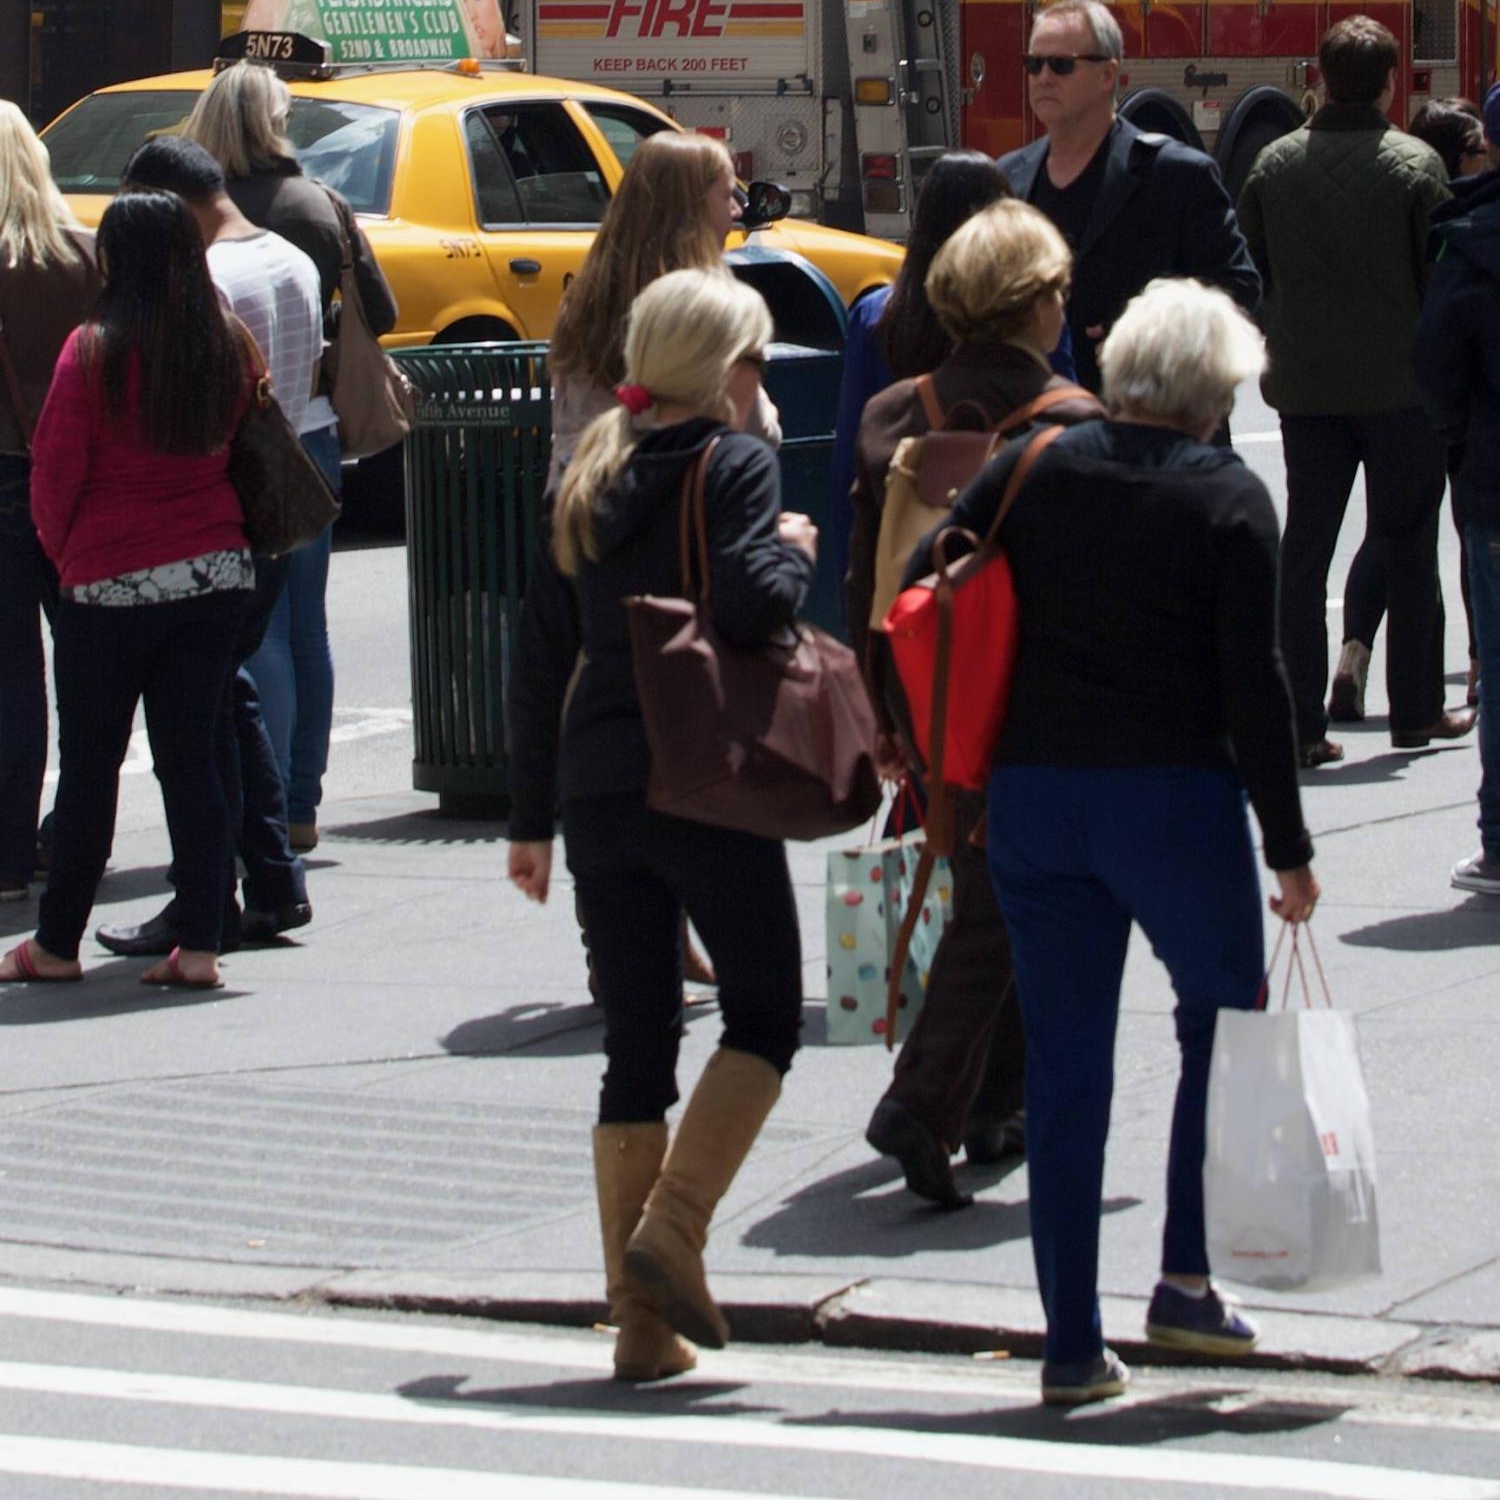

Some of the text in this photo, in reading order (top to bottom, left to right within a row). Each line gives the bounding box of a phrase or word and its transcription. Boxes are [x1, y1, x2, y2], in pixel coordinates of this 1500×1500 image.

[323, 10, 460, 35] GENTLEMEN'S CLUB
[246, 34, 294, 59] 5N73
[340, 38, 453, 58] 52ND & BROADWAY
[593, 57, 749, 72] KEEP BACK 200 FEET
[446, 403, 510, 420] Avenue
